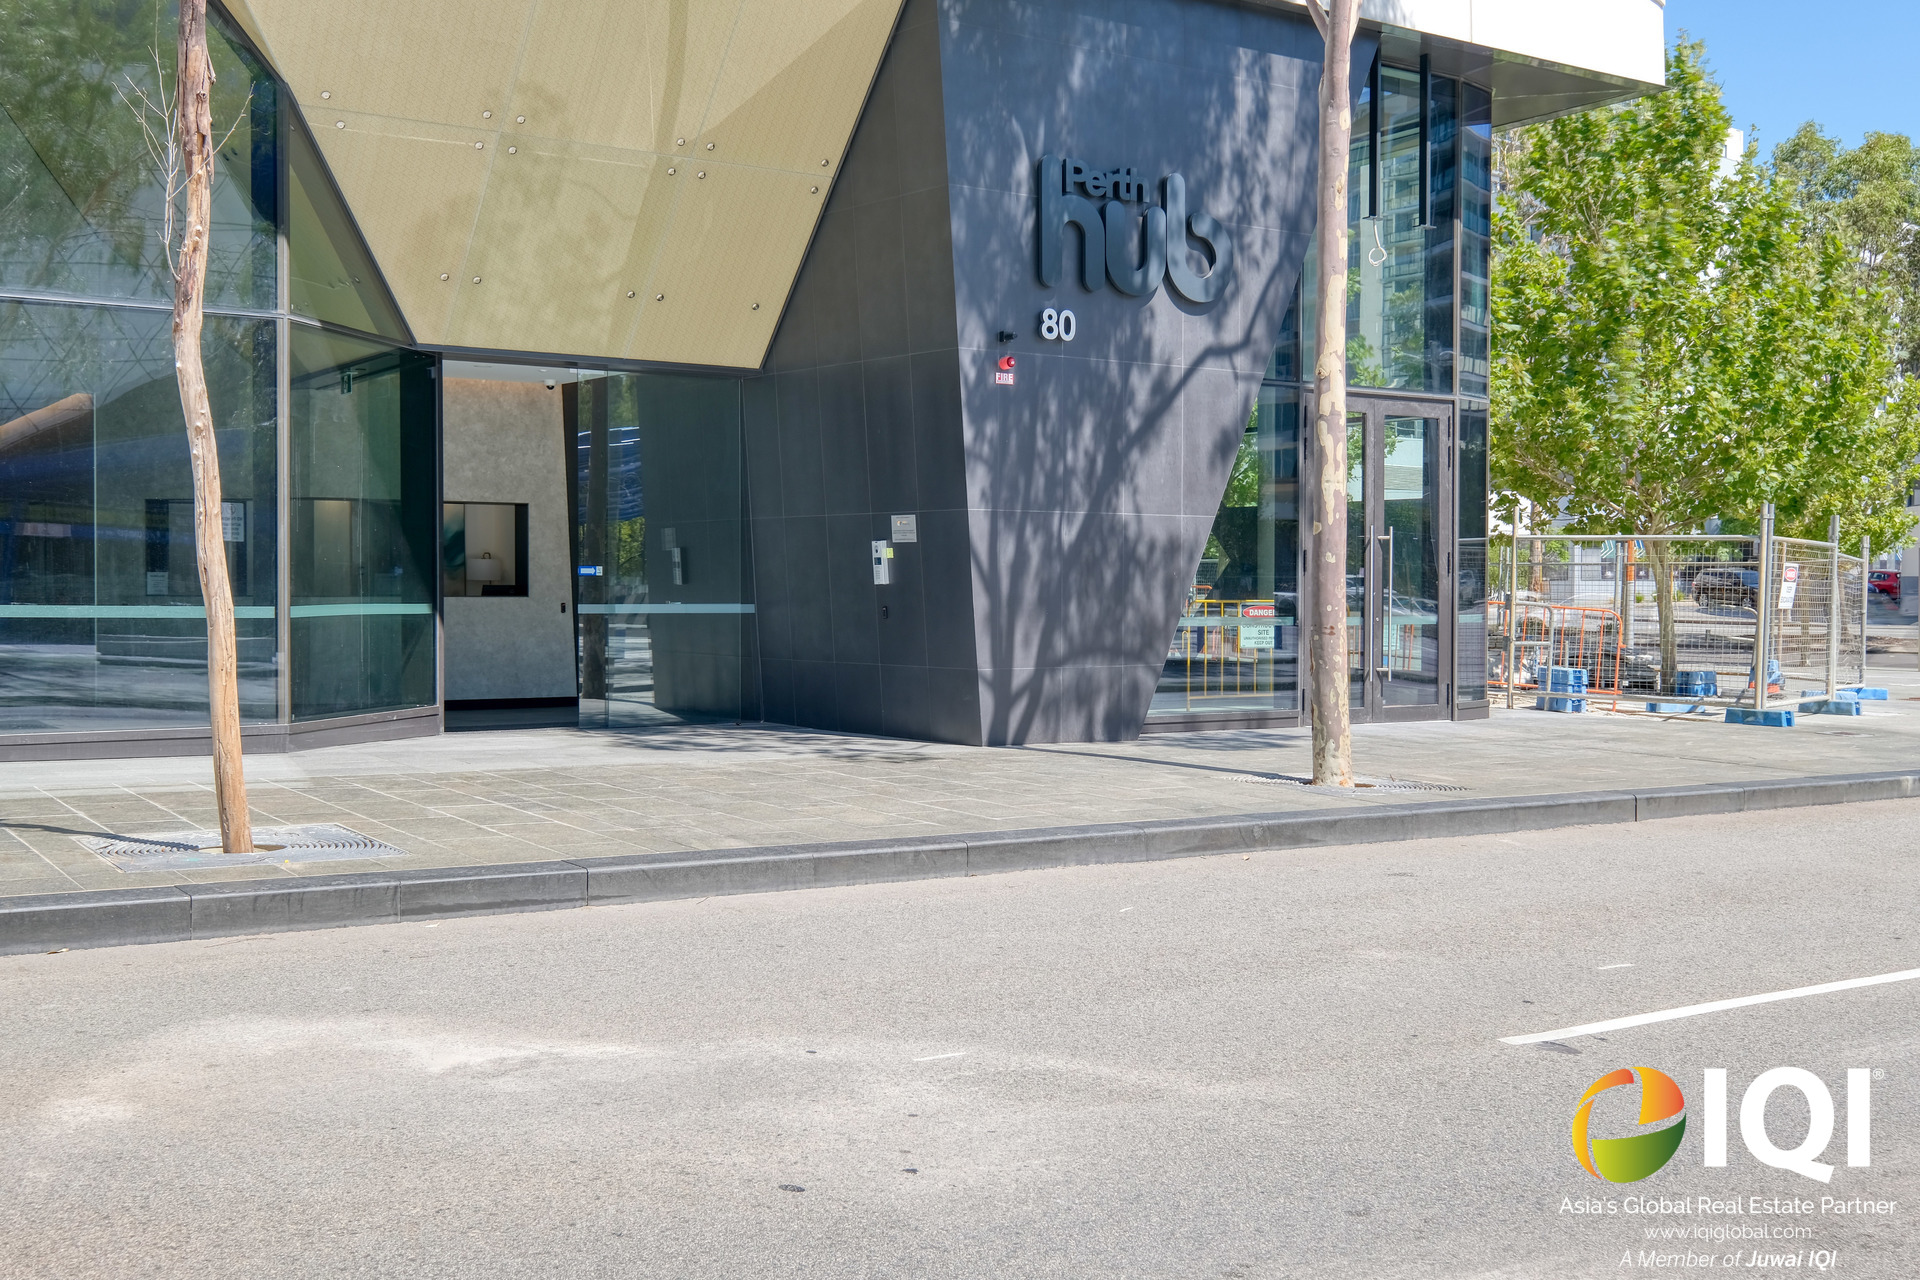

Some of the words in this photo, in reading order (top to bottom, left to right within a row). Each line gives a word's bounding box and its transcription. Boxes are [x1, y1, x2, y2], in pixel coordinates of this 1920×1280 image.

[1064, 157, 1149, 203] Perth
[1039, 154, 1233, 303] hub
[1041, 307, 1076, 341] 80
[995, 372, 1013, 381] FIRE
